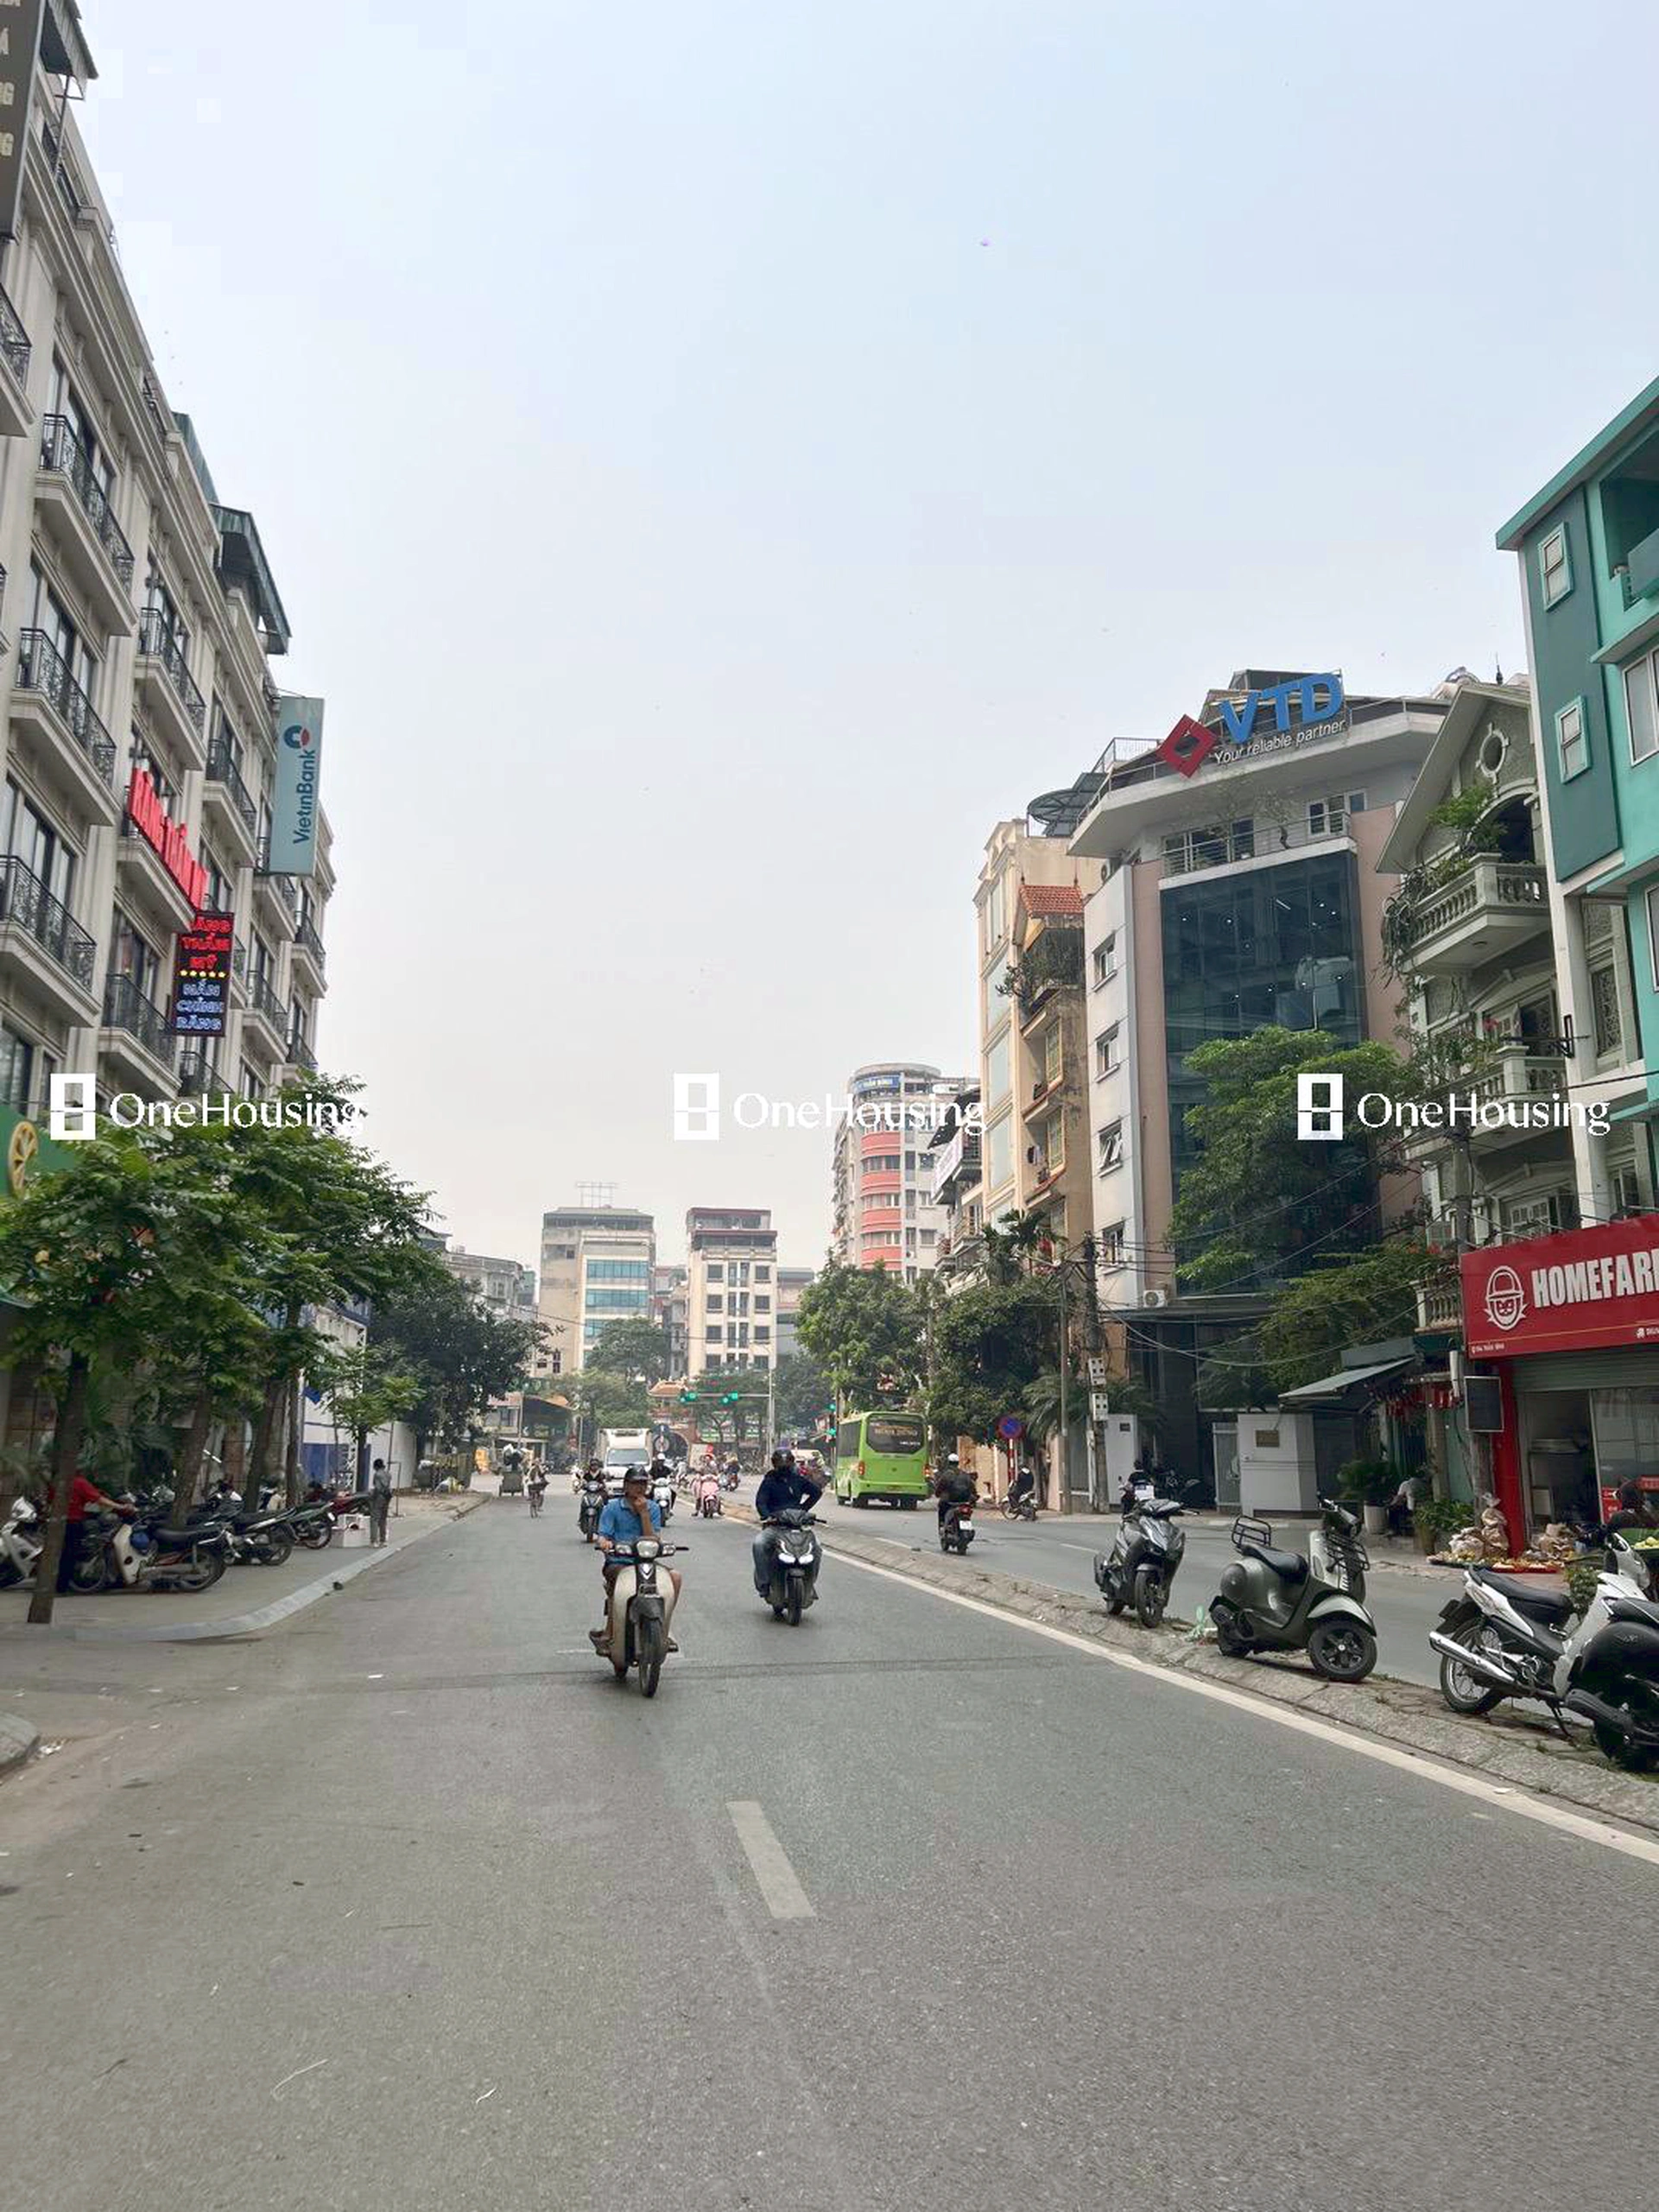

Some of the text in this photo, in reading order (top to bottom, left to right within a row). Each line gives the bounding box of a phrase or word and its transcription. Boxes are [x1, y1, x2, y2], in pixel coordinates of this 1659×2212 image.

[1213, 719, 1346, 765] Your reliable partner
[1219, 673, 1344, 745] VTD
[293, 750, 316, 845] VietinBank
